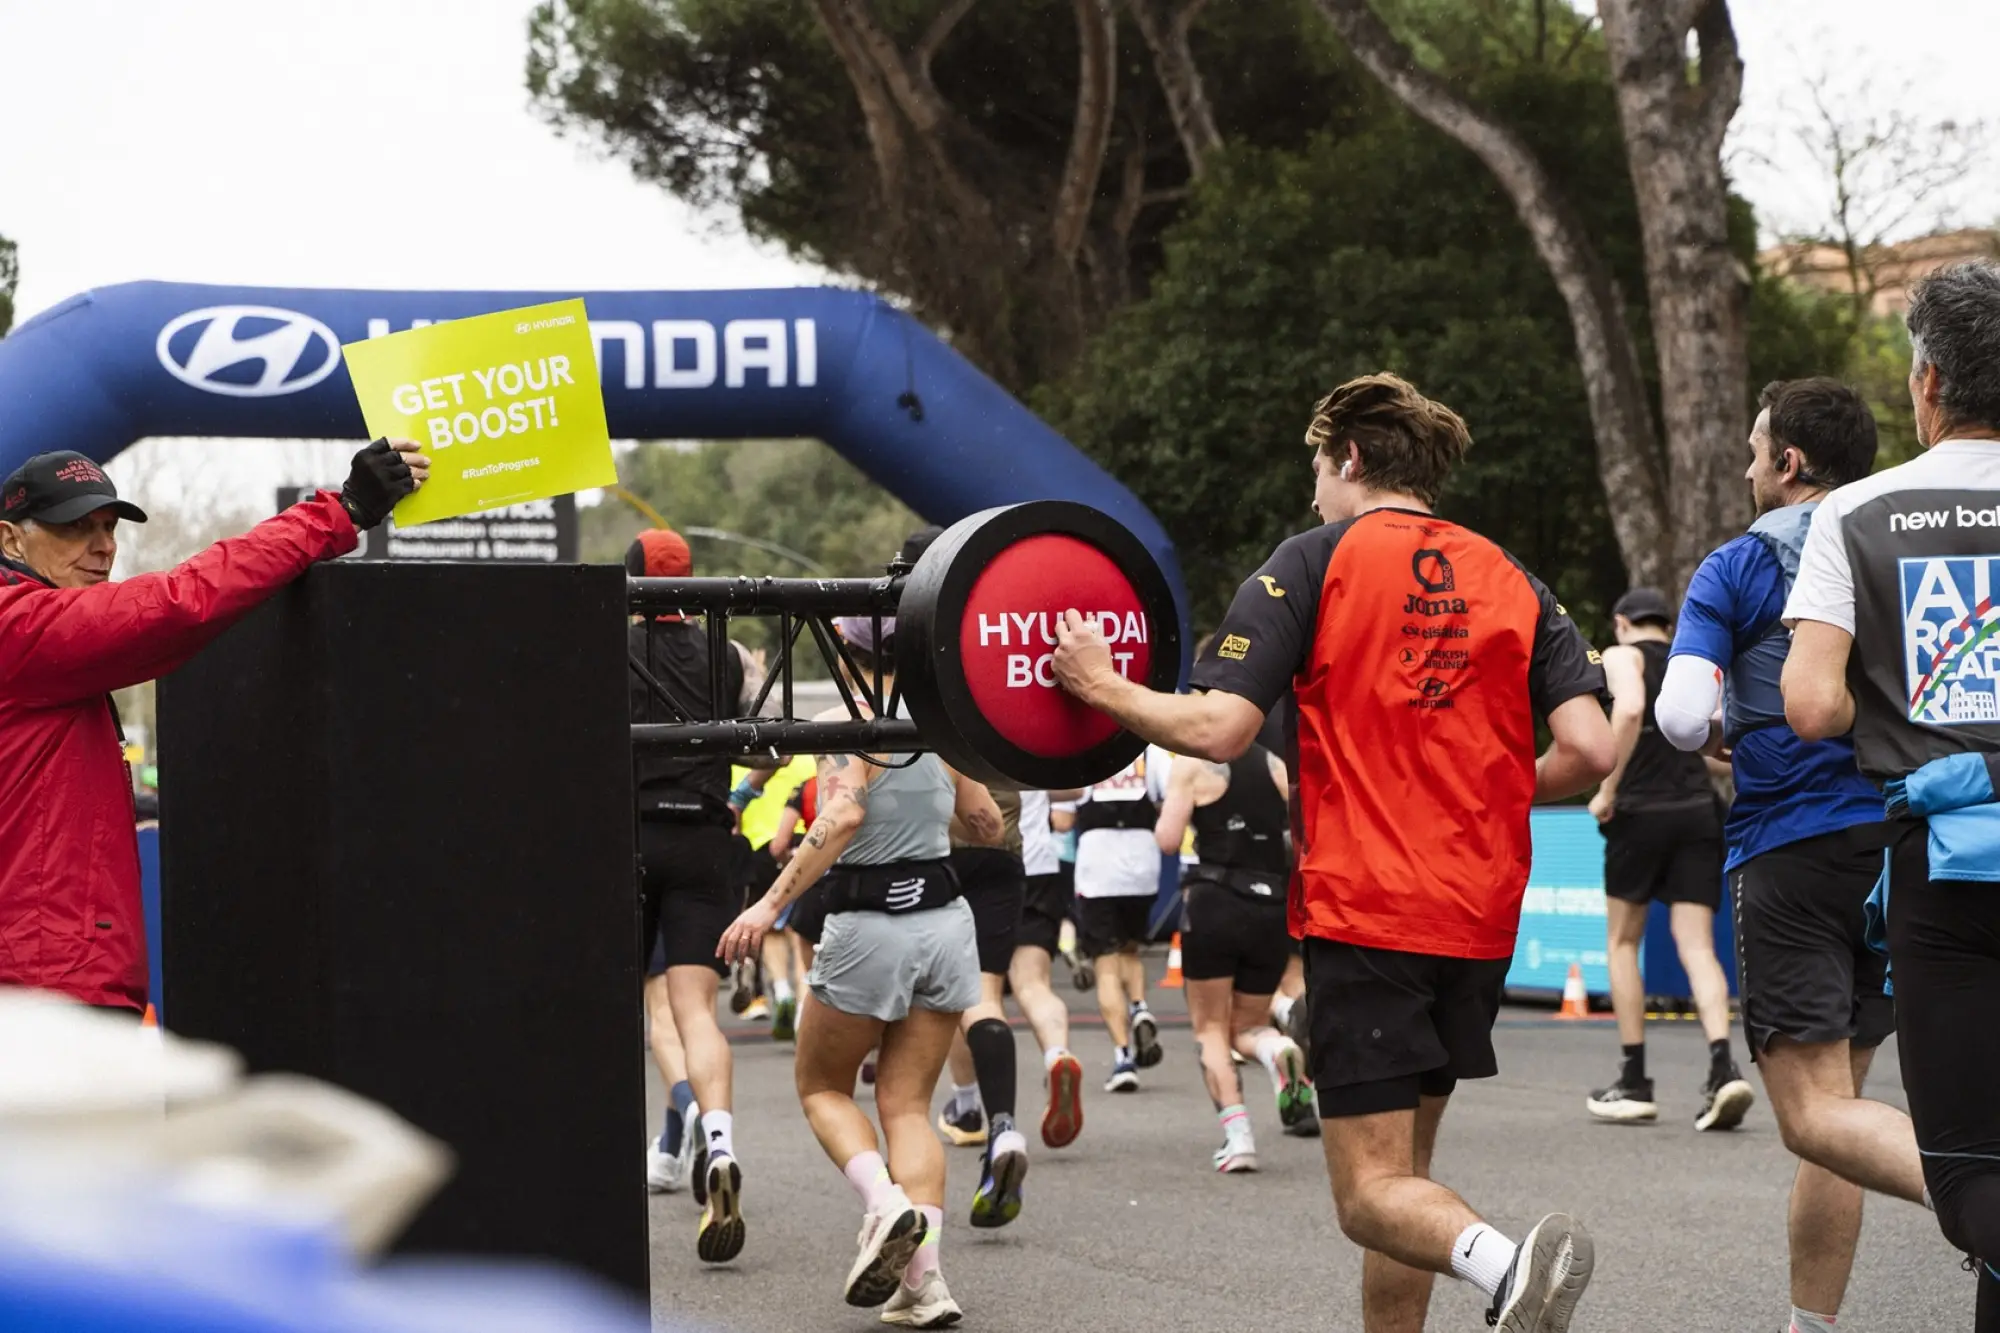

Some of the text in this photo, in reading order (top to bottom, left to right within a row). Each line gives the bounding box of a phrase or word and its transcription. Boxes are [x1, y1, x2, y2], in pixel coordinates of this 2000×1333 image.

[533, 315, 576, 330] HYUNDAI
[368, 317, 818, 389] NDAI
[392, 355, 575, 416] GET YOUR
[427, 396, 560, 450] BOOST!
[462, 457, 540, 479] #RunToProgress
[1889, 509, 1949, 532] new
[978, 611, 1148, 647] HYUDAI
[1006, 652, 1135, 688] BOT
